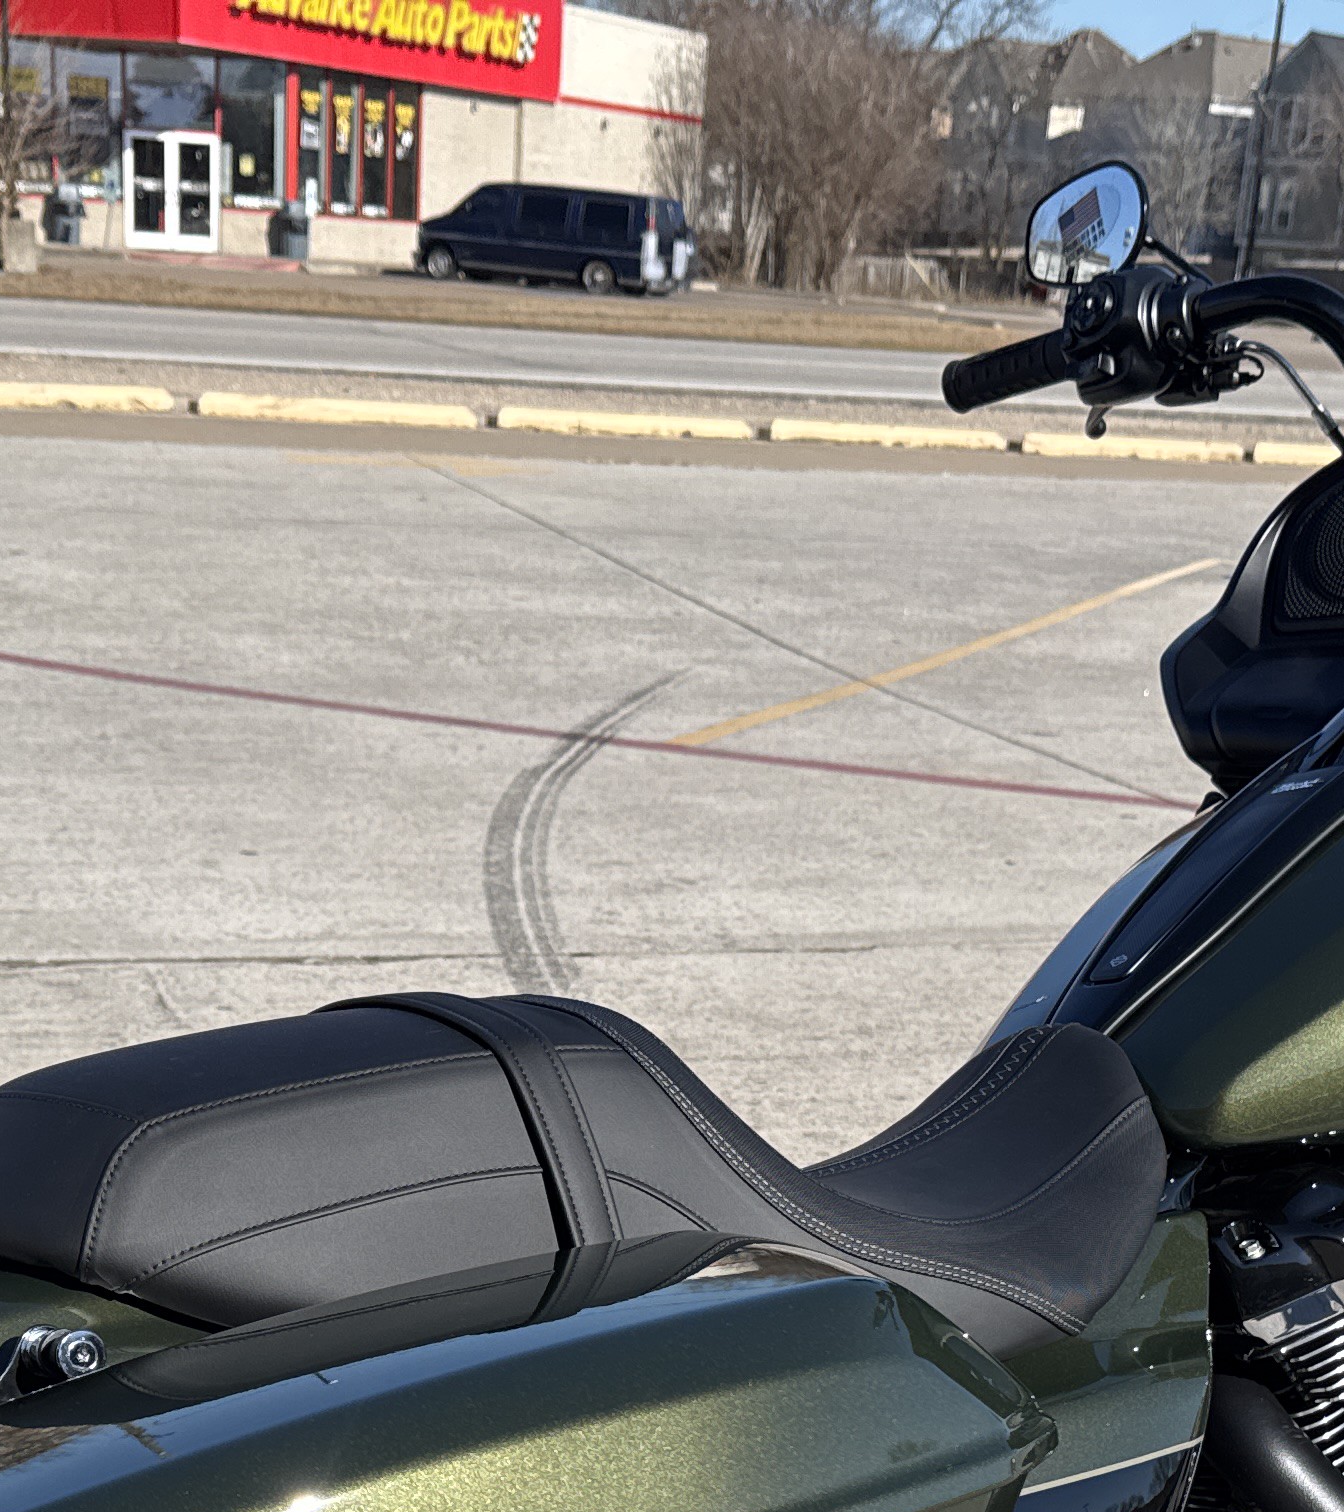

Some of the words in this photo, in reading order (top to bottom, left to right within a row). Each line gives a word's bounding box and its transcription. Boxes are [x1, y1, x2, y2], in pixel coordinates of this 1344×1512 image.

[235, 0, 369, 31] vance
[370, 0, 445, 45] Auto
[444, 2, 515, 57] Parts
